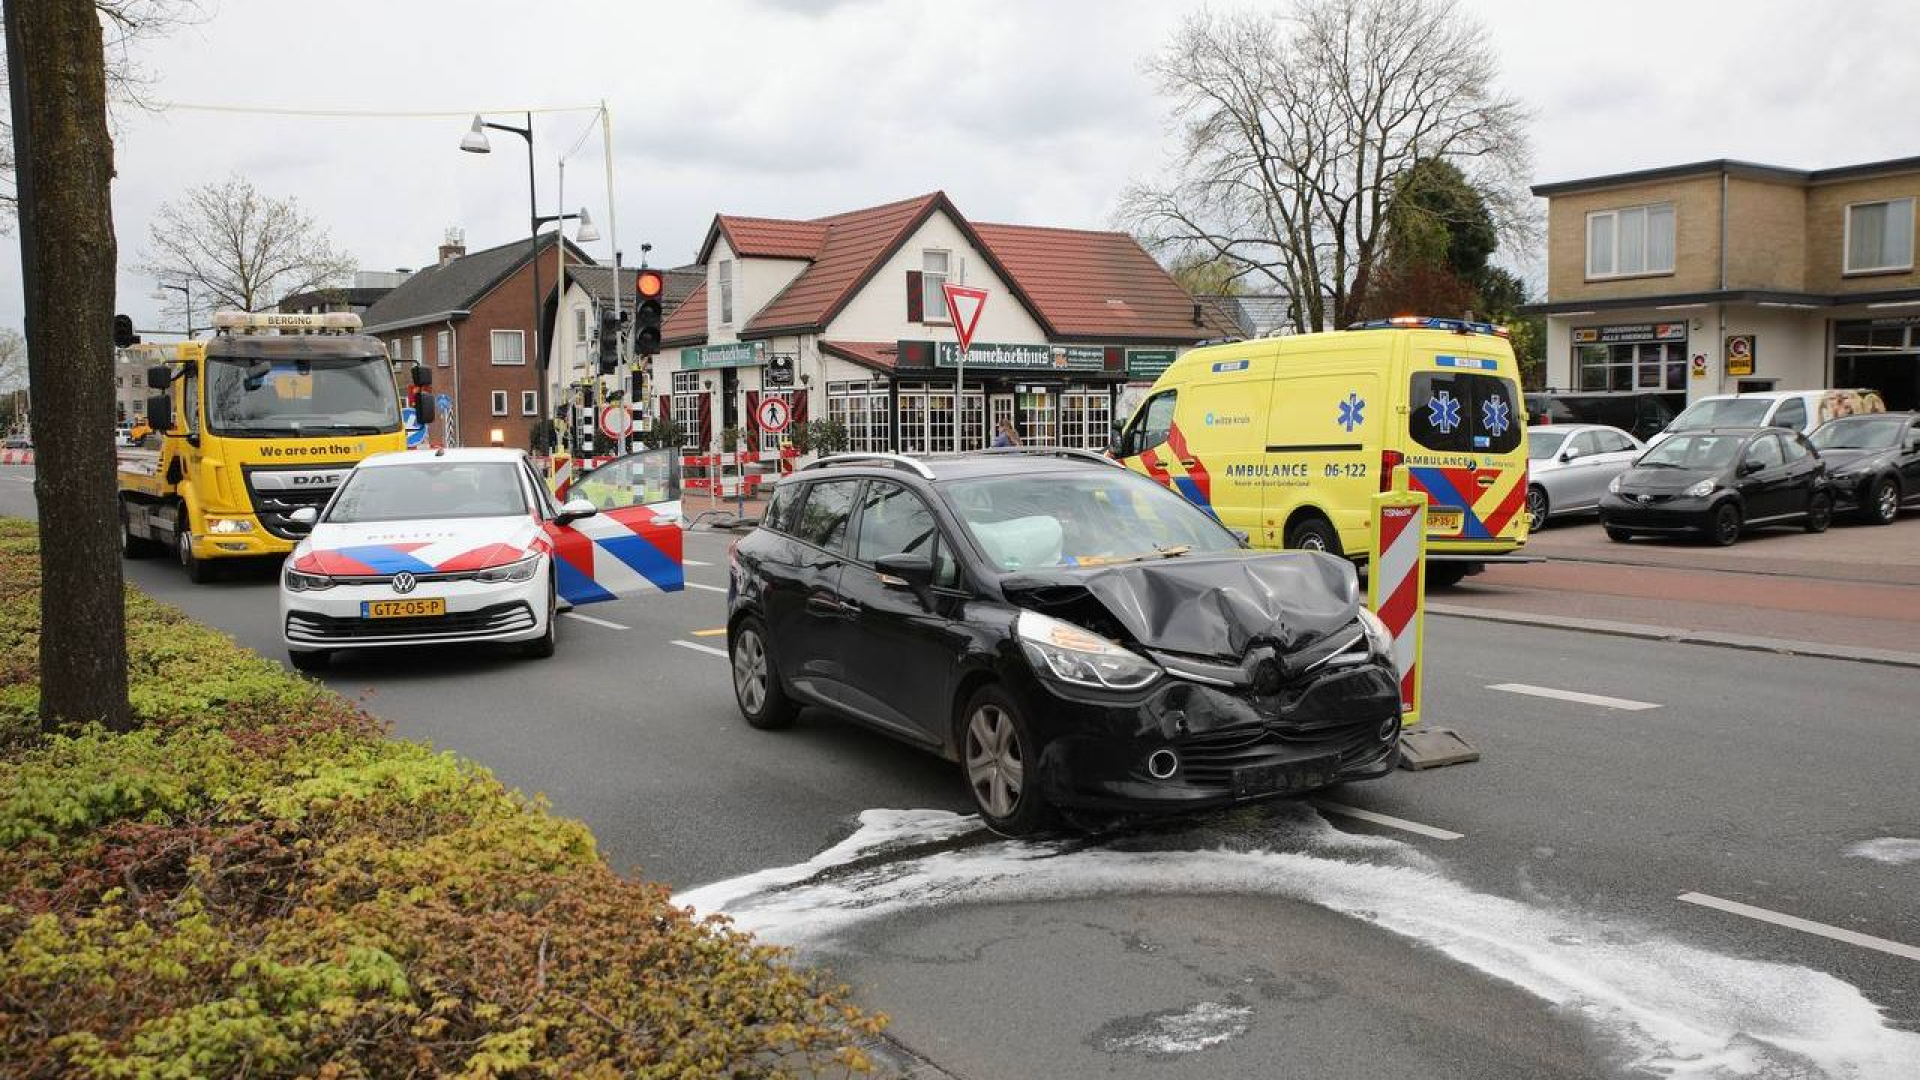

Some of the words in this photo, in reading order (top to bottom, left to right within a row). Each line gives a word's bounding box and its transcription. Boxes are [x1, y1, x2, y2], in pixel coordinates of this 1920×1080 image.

[268, 316, 312, 325] BERGING
[260, 446, 282, 456] We
[285, 447, 307, 455] are
[310, 446, 326, 455] on
[330, 444, 350, 454] the
[1405, 455, 1467, 466] AMBULANCE
[1226, 464, 1308, 477] AMBULANCE
[1325, 463, 1366, 477] 06-122
[294, 475, 340, 483] DAF
[374, 601, 438, 615] GTZ-05-P
